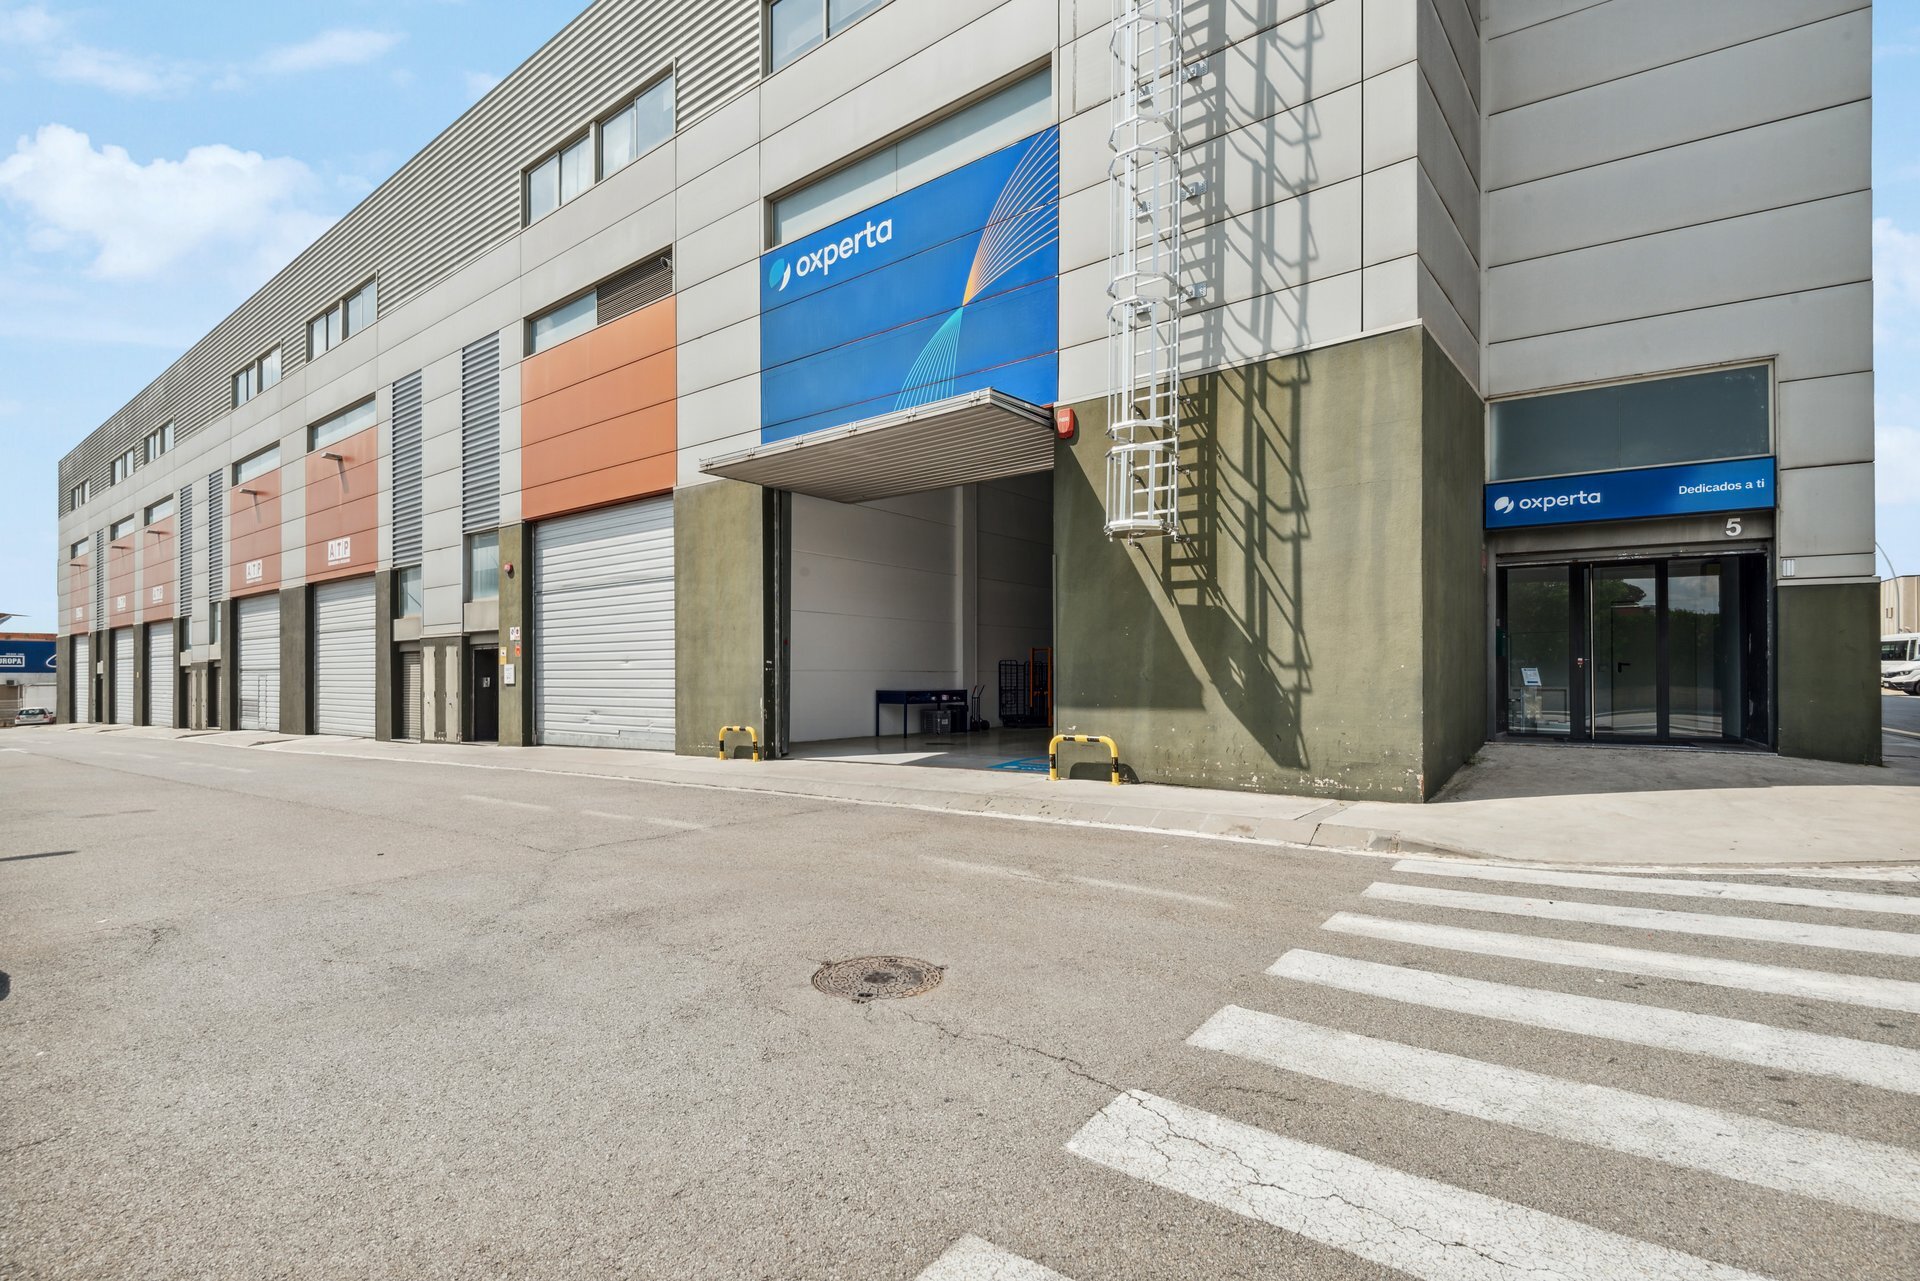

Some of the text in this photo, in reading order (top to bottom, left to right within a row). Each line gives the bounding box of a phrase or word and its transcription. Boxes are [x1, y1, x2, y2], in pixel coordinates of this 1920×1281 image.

[796, 219, 892, 276] oxperta
[1679, 478, 1765, 495] Dedicados a ti
[1519, 490, 1601, 512] oxperta
[1725, 517, 1742, 537] 5
[329, 540, 349, 558] ATP
